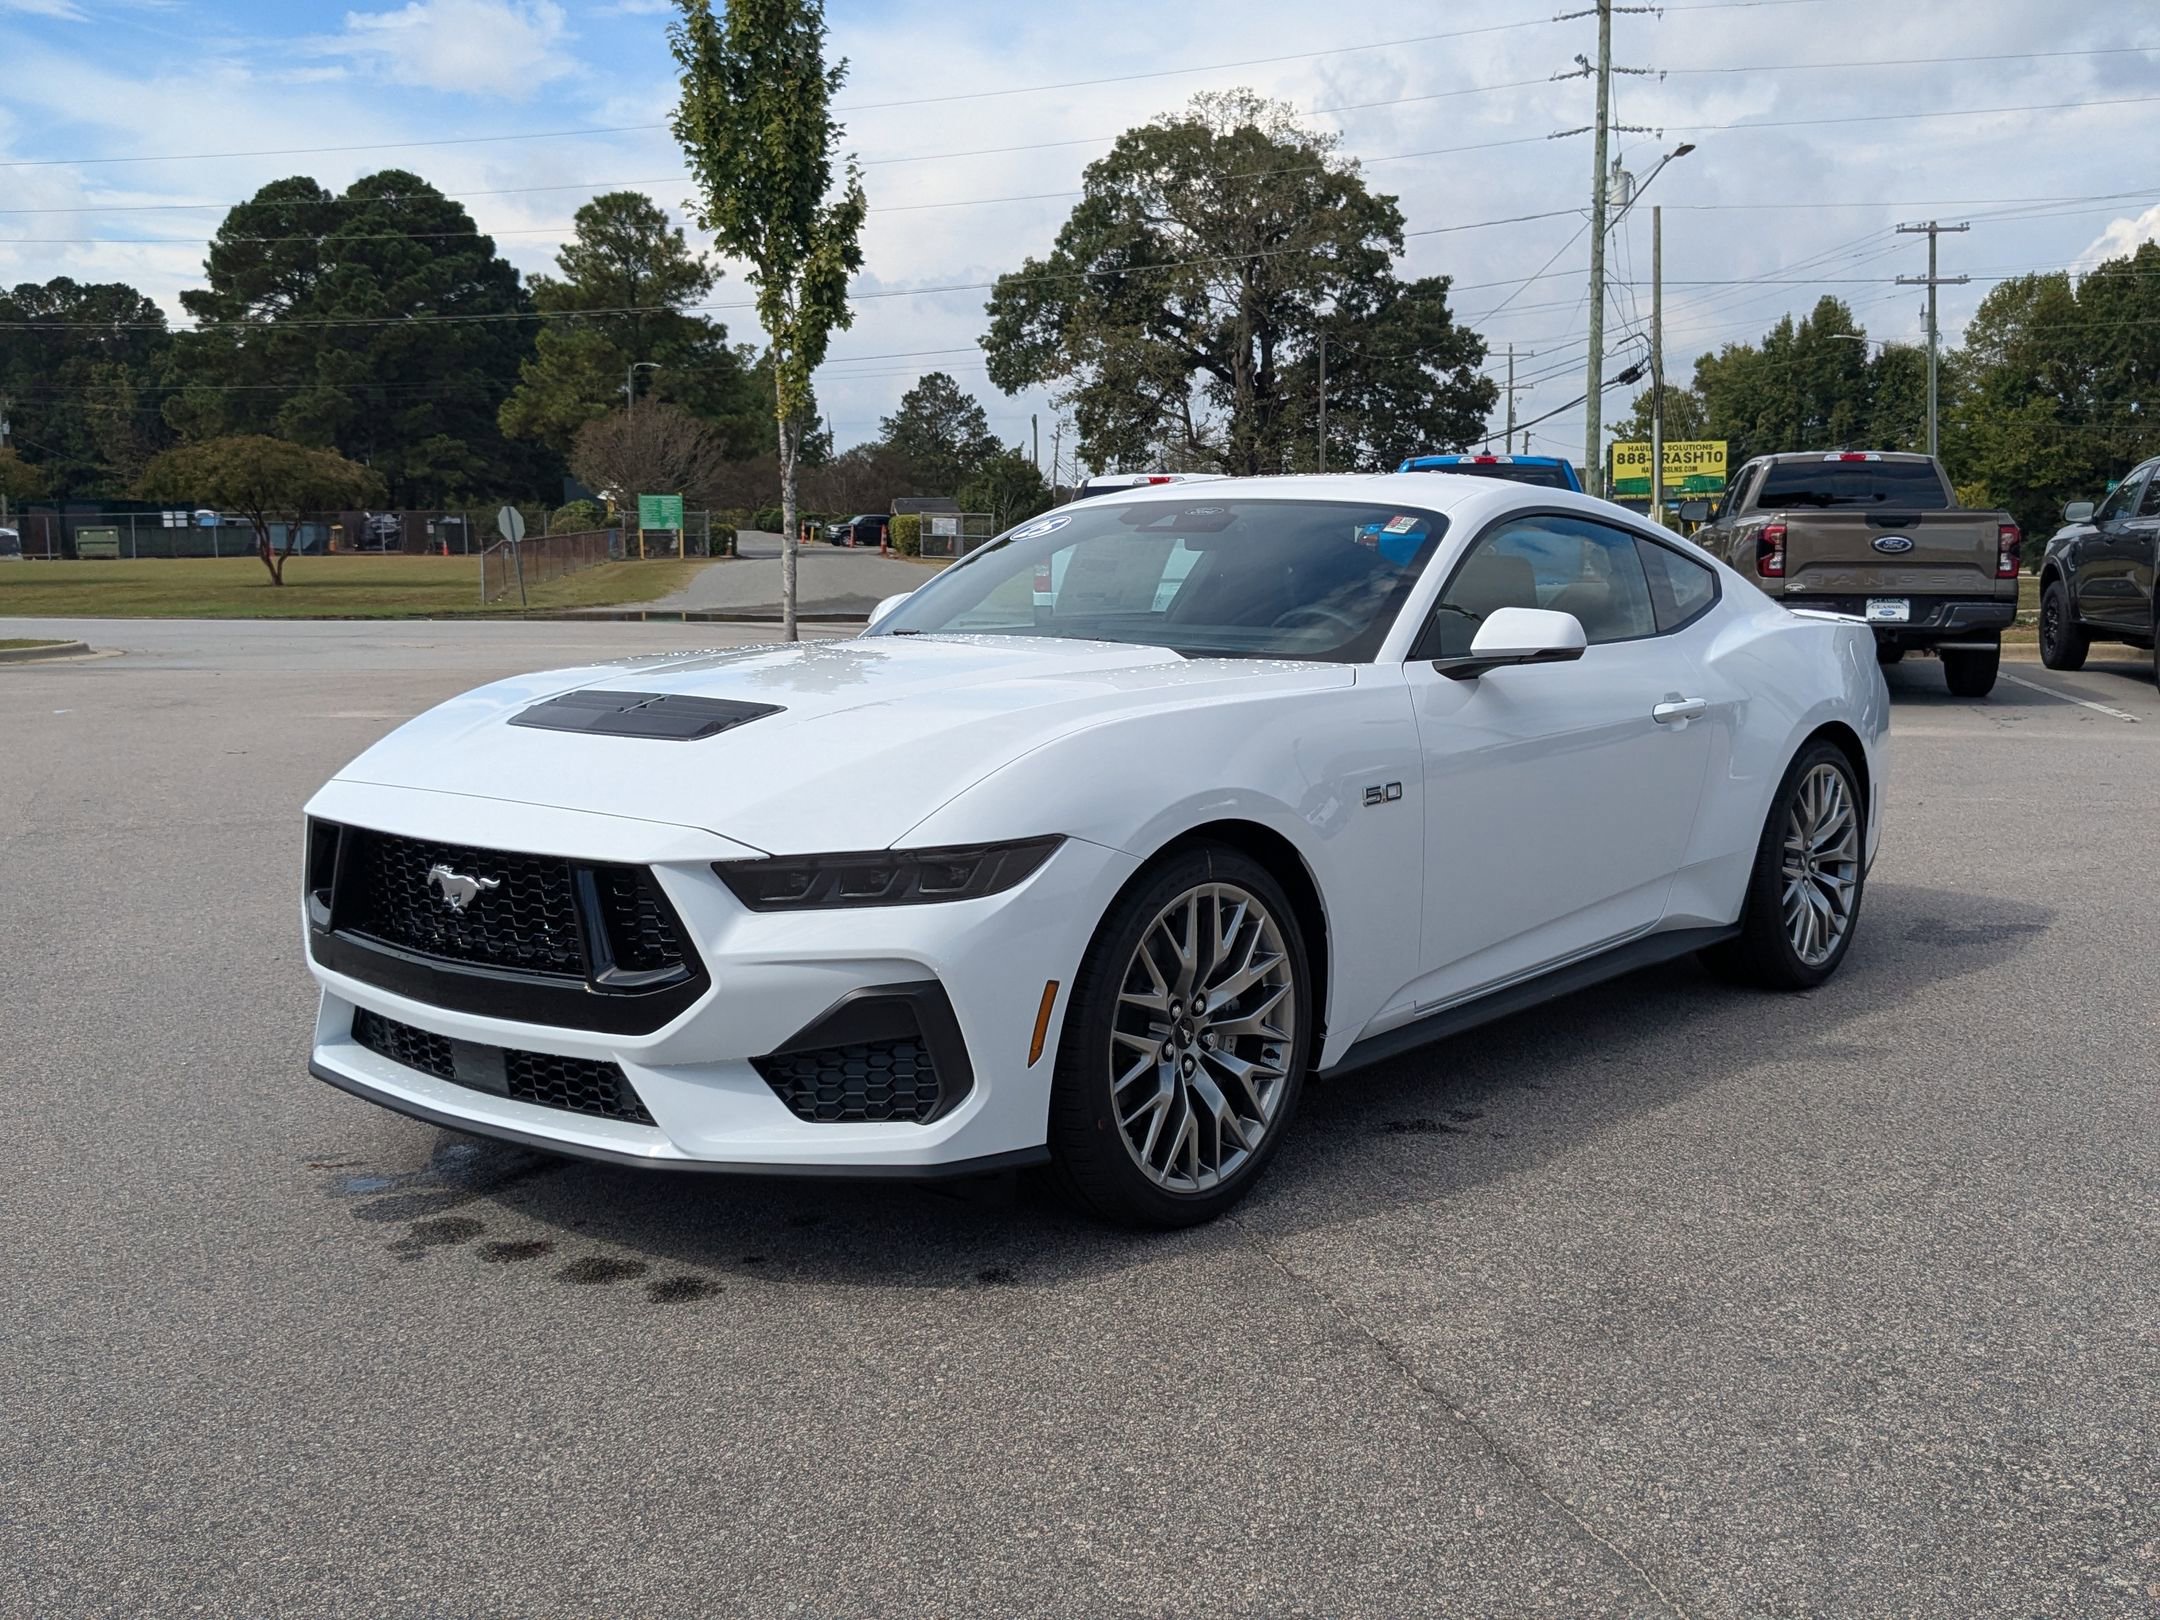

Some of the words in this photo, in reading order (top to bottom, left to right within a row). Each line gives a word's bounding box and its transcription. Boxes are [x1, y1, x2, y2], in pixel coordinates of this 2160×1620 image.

[1628, 444, 1664, 452] HAUL
[1667, 443, 1714, 452] SOLUTIONS
[1616, 451, 1723, 465] 888-RASH10
[1362, 781, 1403, 807] 5.0
